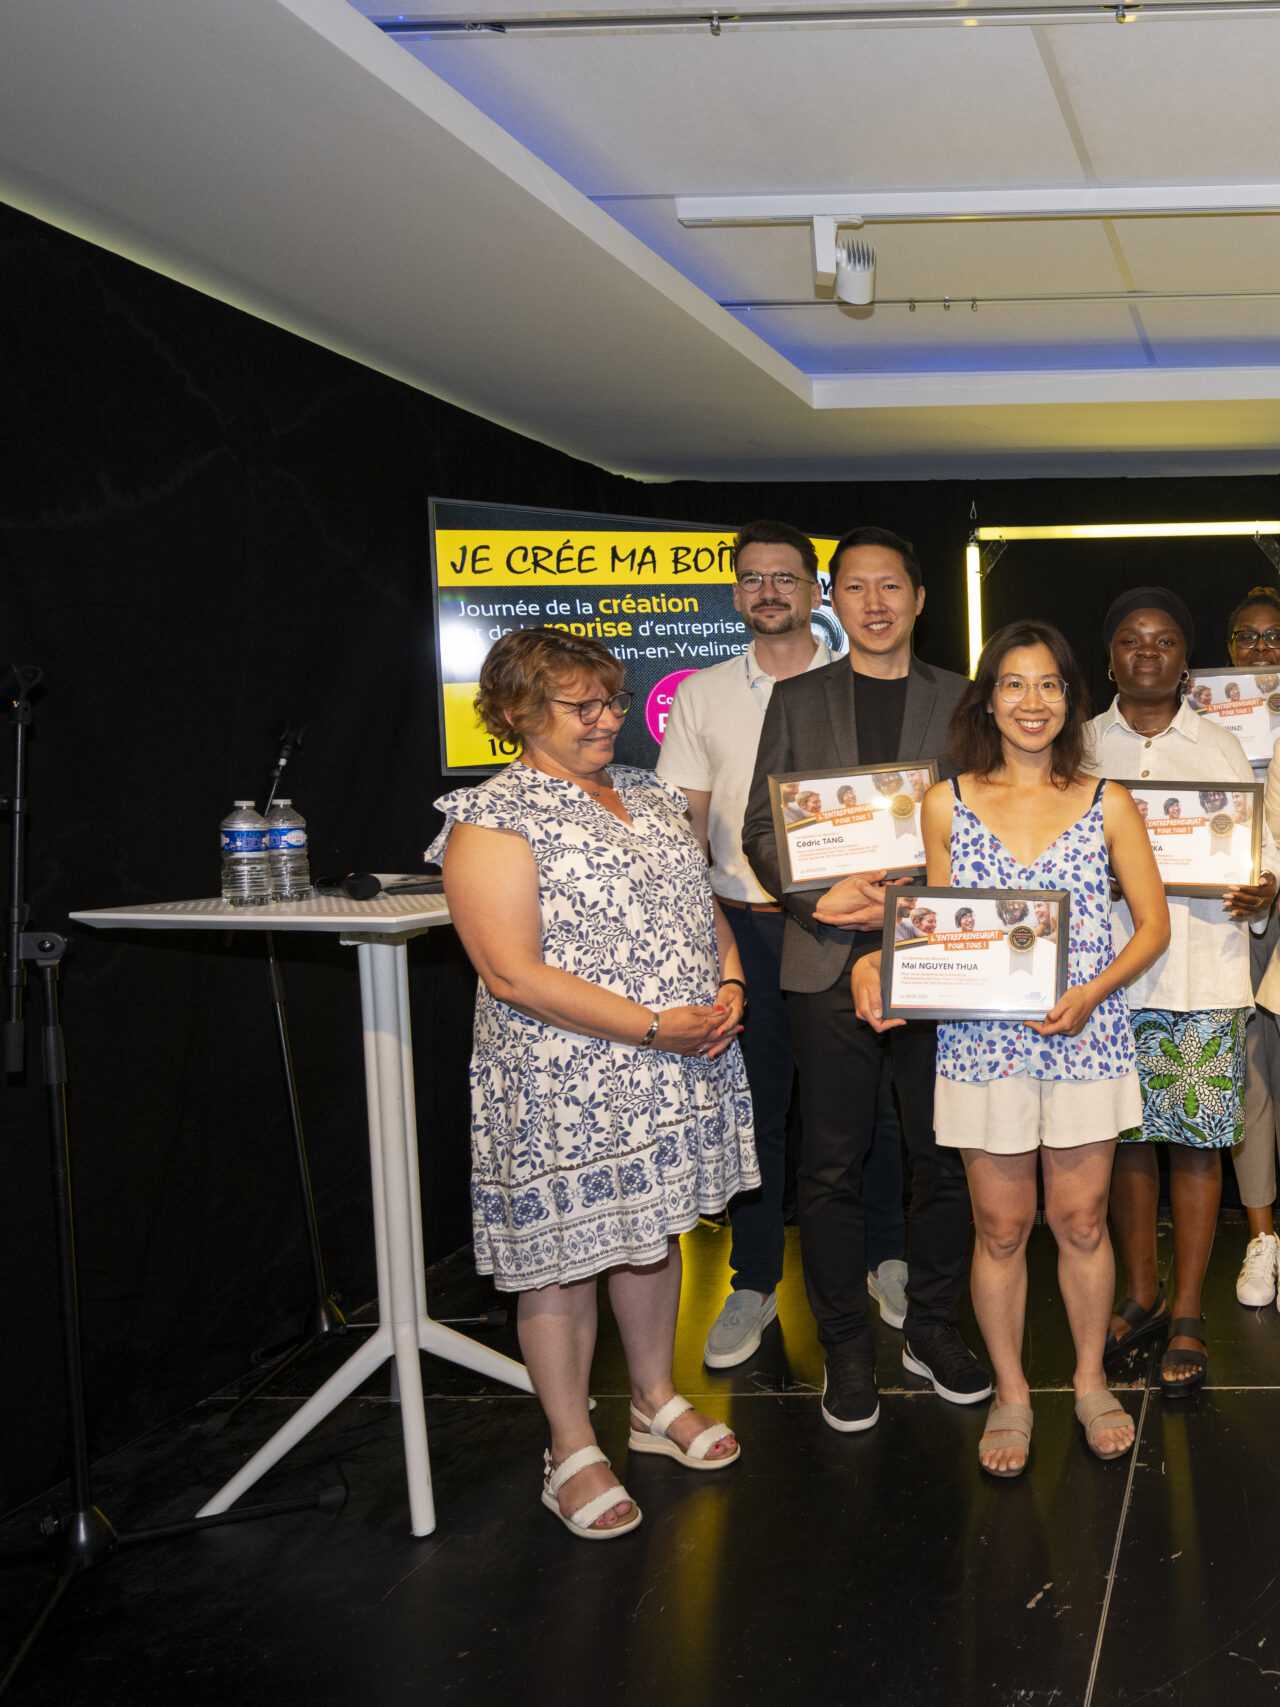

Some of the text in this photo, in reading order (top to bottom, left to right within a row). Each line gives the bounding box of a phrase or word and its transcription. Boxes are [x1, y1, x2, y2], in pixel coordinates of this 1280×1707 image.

[450, 539, 736, 575] JE CRÉE MA BOÎT
[459, 593, 699, 617] Journée de la création
[638, 619, 746, 637] d'entreprise
[608, 641, 749, 660] tin-en-Yvelines
[822, 836, 844, 845] TANG
[901, 961, 979, 971] Mai NGUYEN THUA
